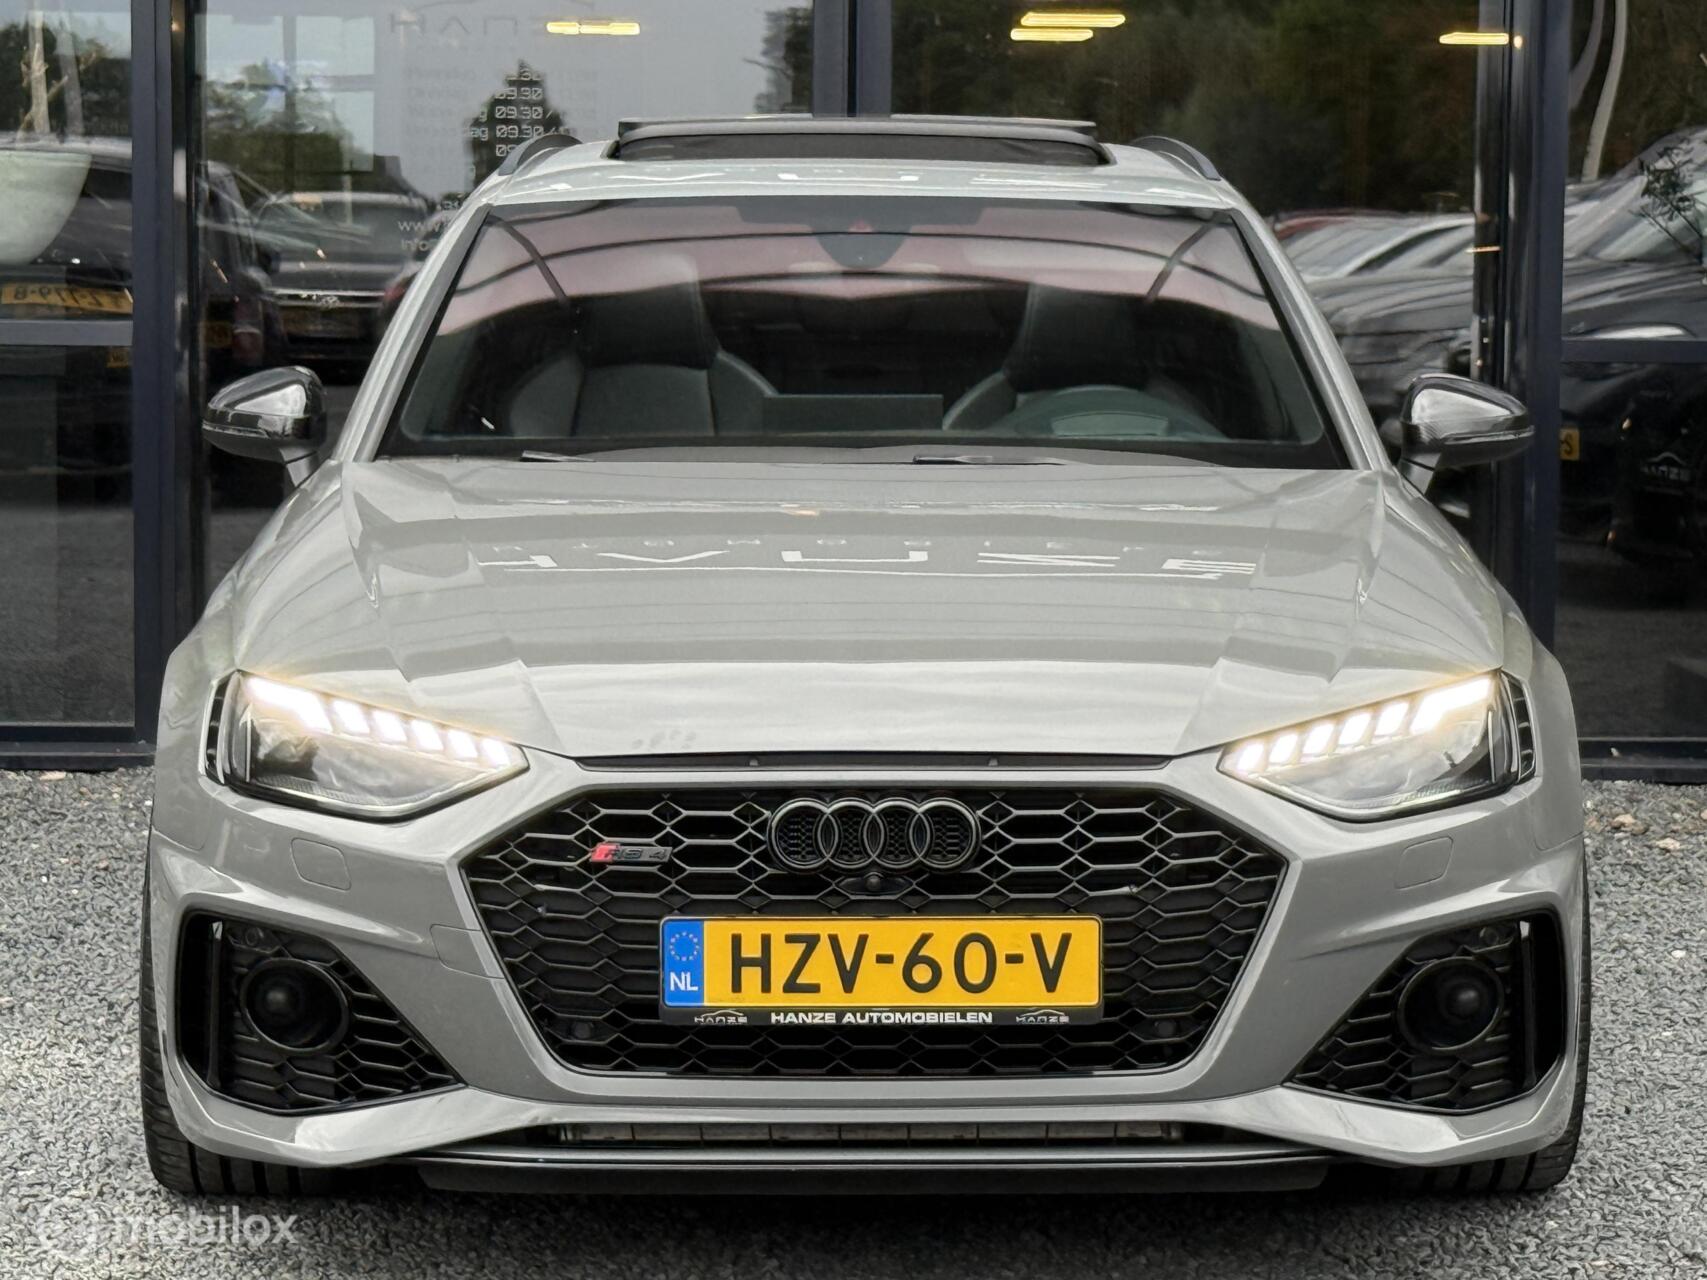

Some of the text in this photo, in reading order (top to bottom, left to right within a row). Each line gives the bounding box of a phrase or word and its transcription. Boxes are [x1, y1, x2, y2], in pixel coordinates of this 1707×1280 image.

[730, 932, 1073, 994] HZV-60-V
[669, 972, 699, 991] NL
[770, 1011, 993, 1025] HANZE AUTOMOBIELEN
